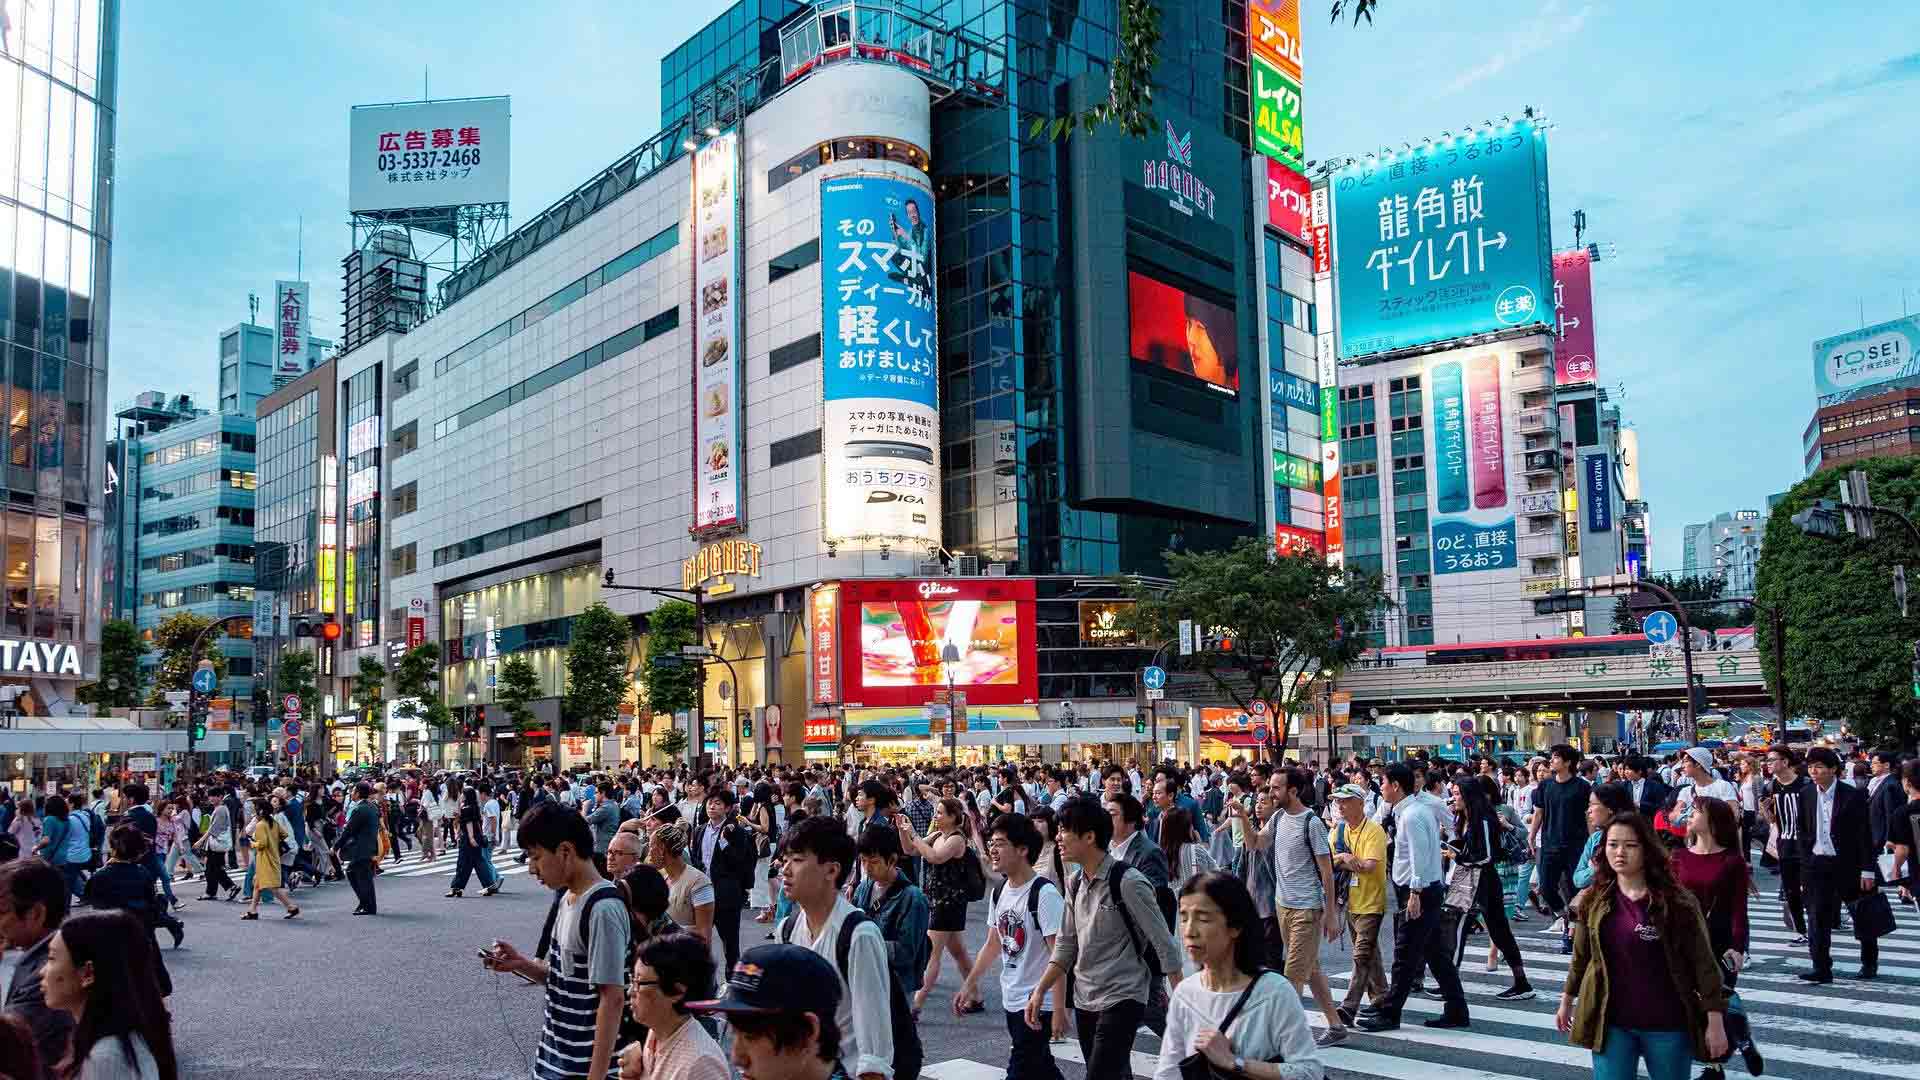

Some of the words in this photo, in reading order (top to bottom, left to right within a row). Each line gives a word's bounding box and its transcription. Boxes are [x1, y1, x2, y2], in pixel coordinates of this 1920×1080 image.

[1257, 70, 1300, 118] レイク
[378, 126, 481, 152] 広告募集
[1257, 103, 1302, 153] ALSA
[378, 148, 481, 171] 03-5337-2468
[387, 167, 471, 184] 株式会社タップ
[1143, 159, 1216, 220] MAGNET
[1378, 174, 1486, 242] 龍角散
[837, 218, 875, 237] その
[1497, 294, 1534, 317] 生薬
[838, 304, 933, 355] 軽くして
[1834, 340, 1899, 368] TOSEI
[866, 490, 925, 505] DIGA
[1327, 496, 1339, 529] アコム
[682, 540, 762, 591] MAGNET
[1445, 549, 1504, 570] うるおう
[918, 581, 960, 600] Glico
[0, 640, 80, 675] TAYA
[1584, 661, 1607, 676] JR
